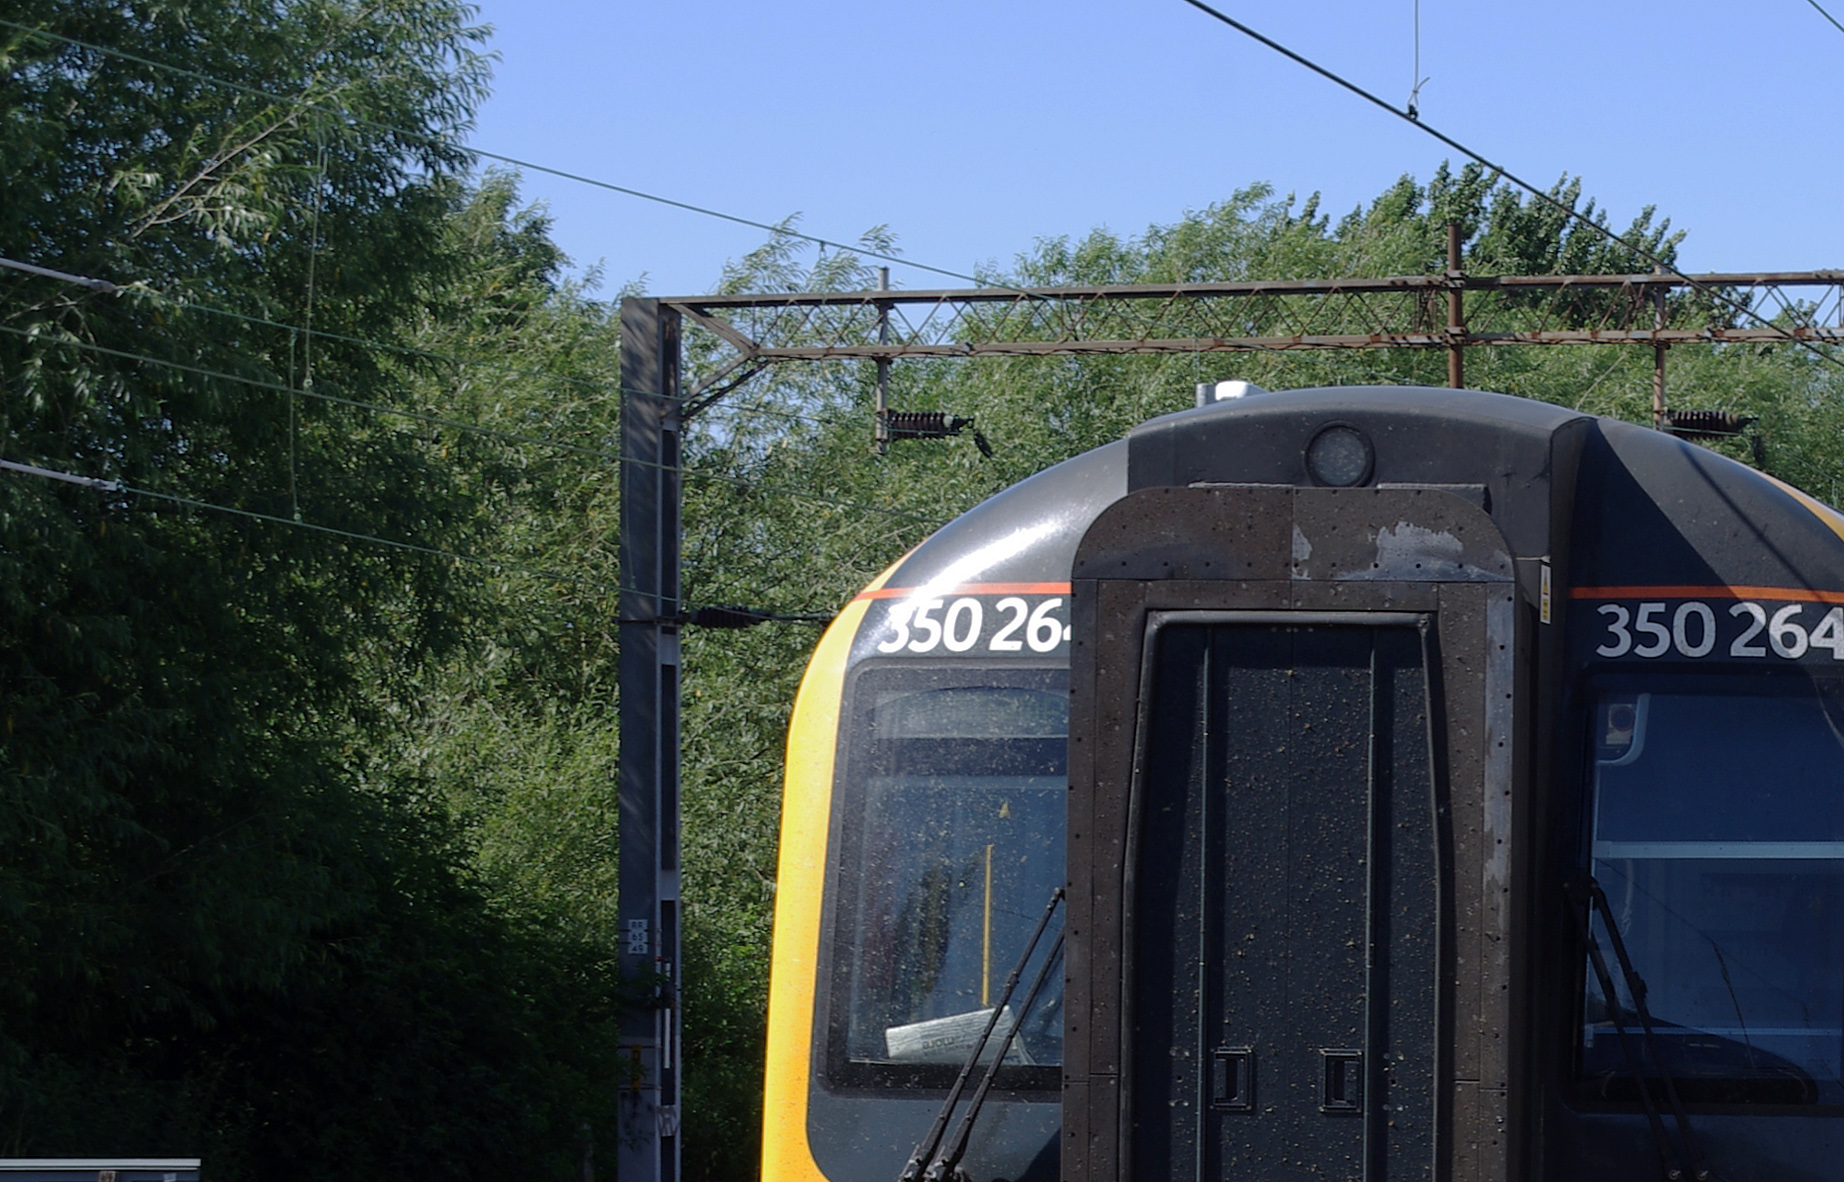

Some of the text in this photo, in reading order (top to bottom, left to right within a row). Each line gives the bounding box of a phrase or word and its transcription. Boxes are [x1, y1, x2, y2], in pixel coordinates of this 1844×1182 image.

[877, 597, 1072, 653] 350 26
[1595, 602, 1717, 658] 350
